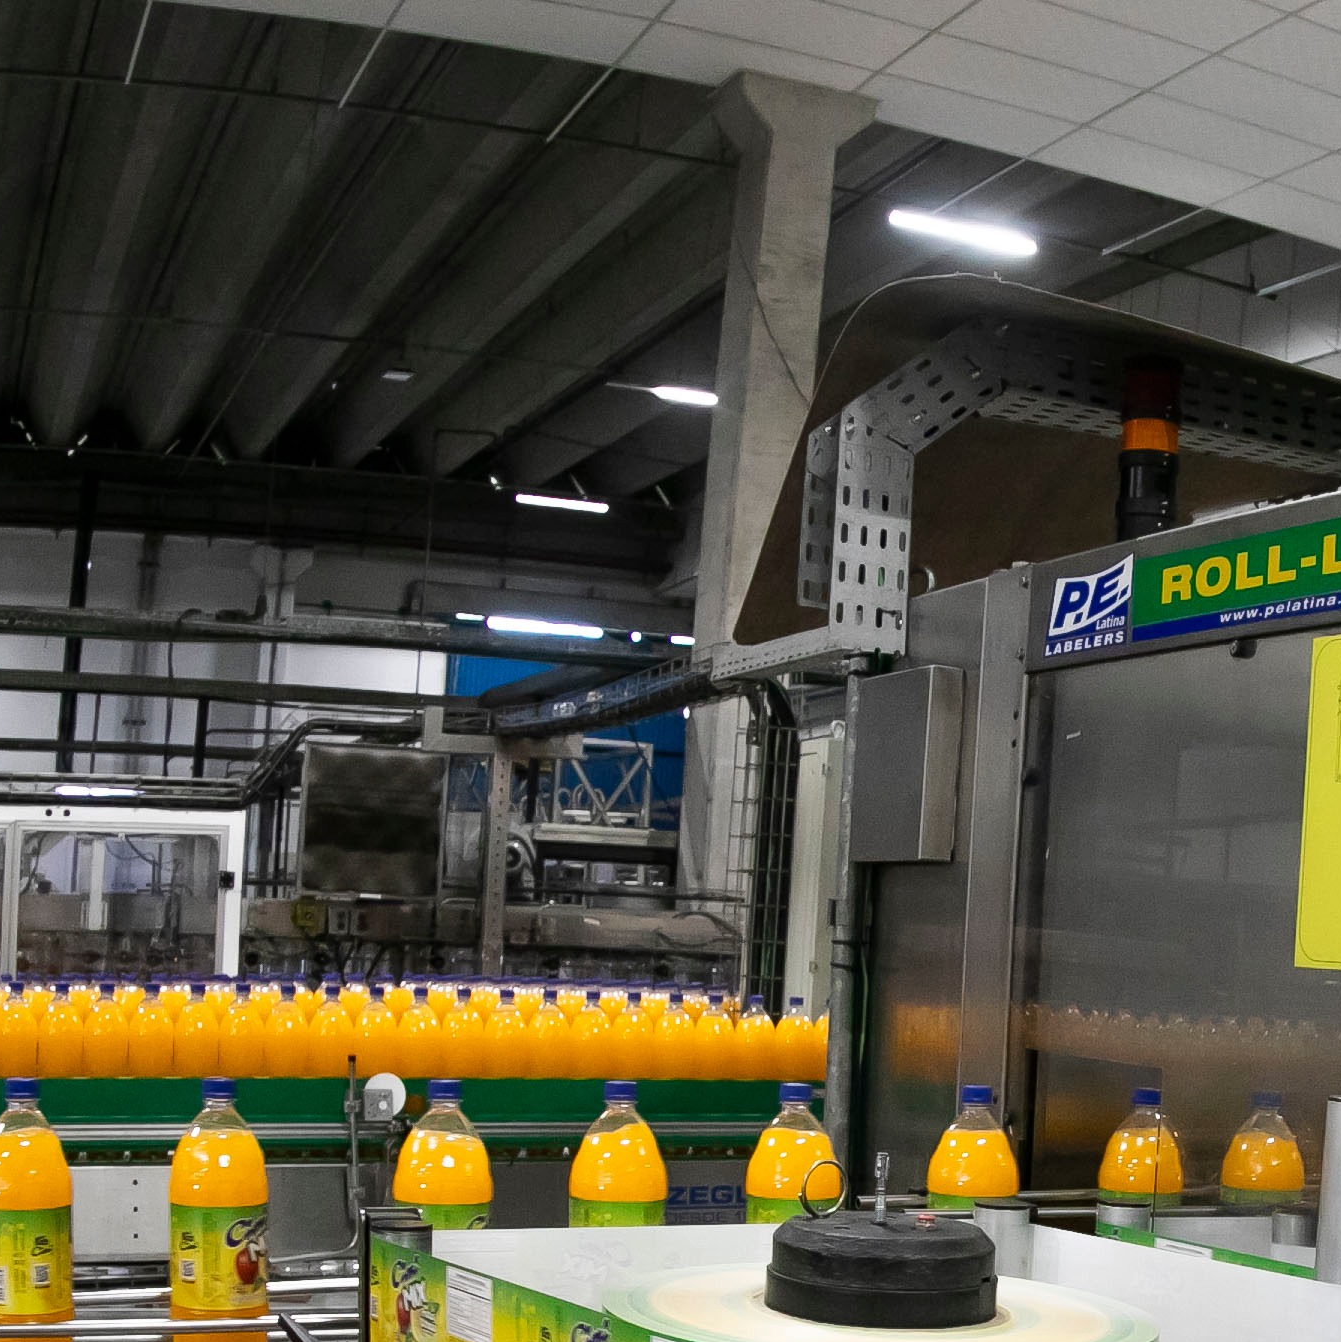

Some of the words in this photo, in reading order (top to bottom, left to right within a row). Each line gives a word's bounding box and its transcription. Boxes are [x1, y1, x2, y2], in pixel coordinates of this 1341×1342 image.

[1096, 615, 1126, 631] Latina
[1044, 631, 1125, 657] LABELERS
[667, 1184, 746, 1206] ZEGL
